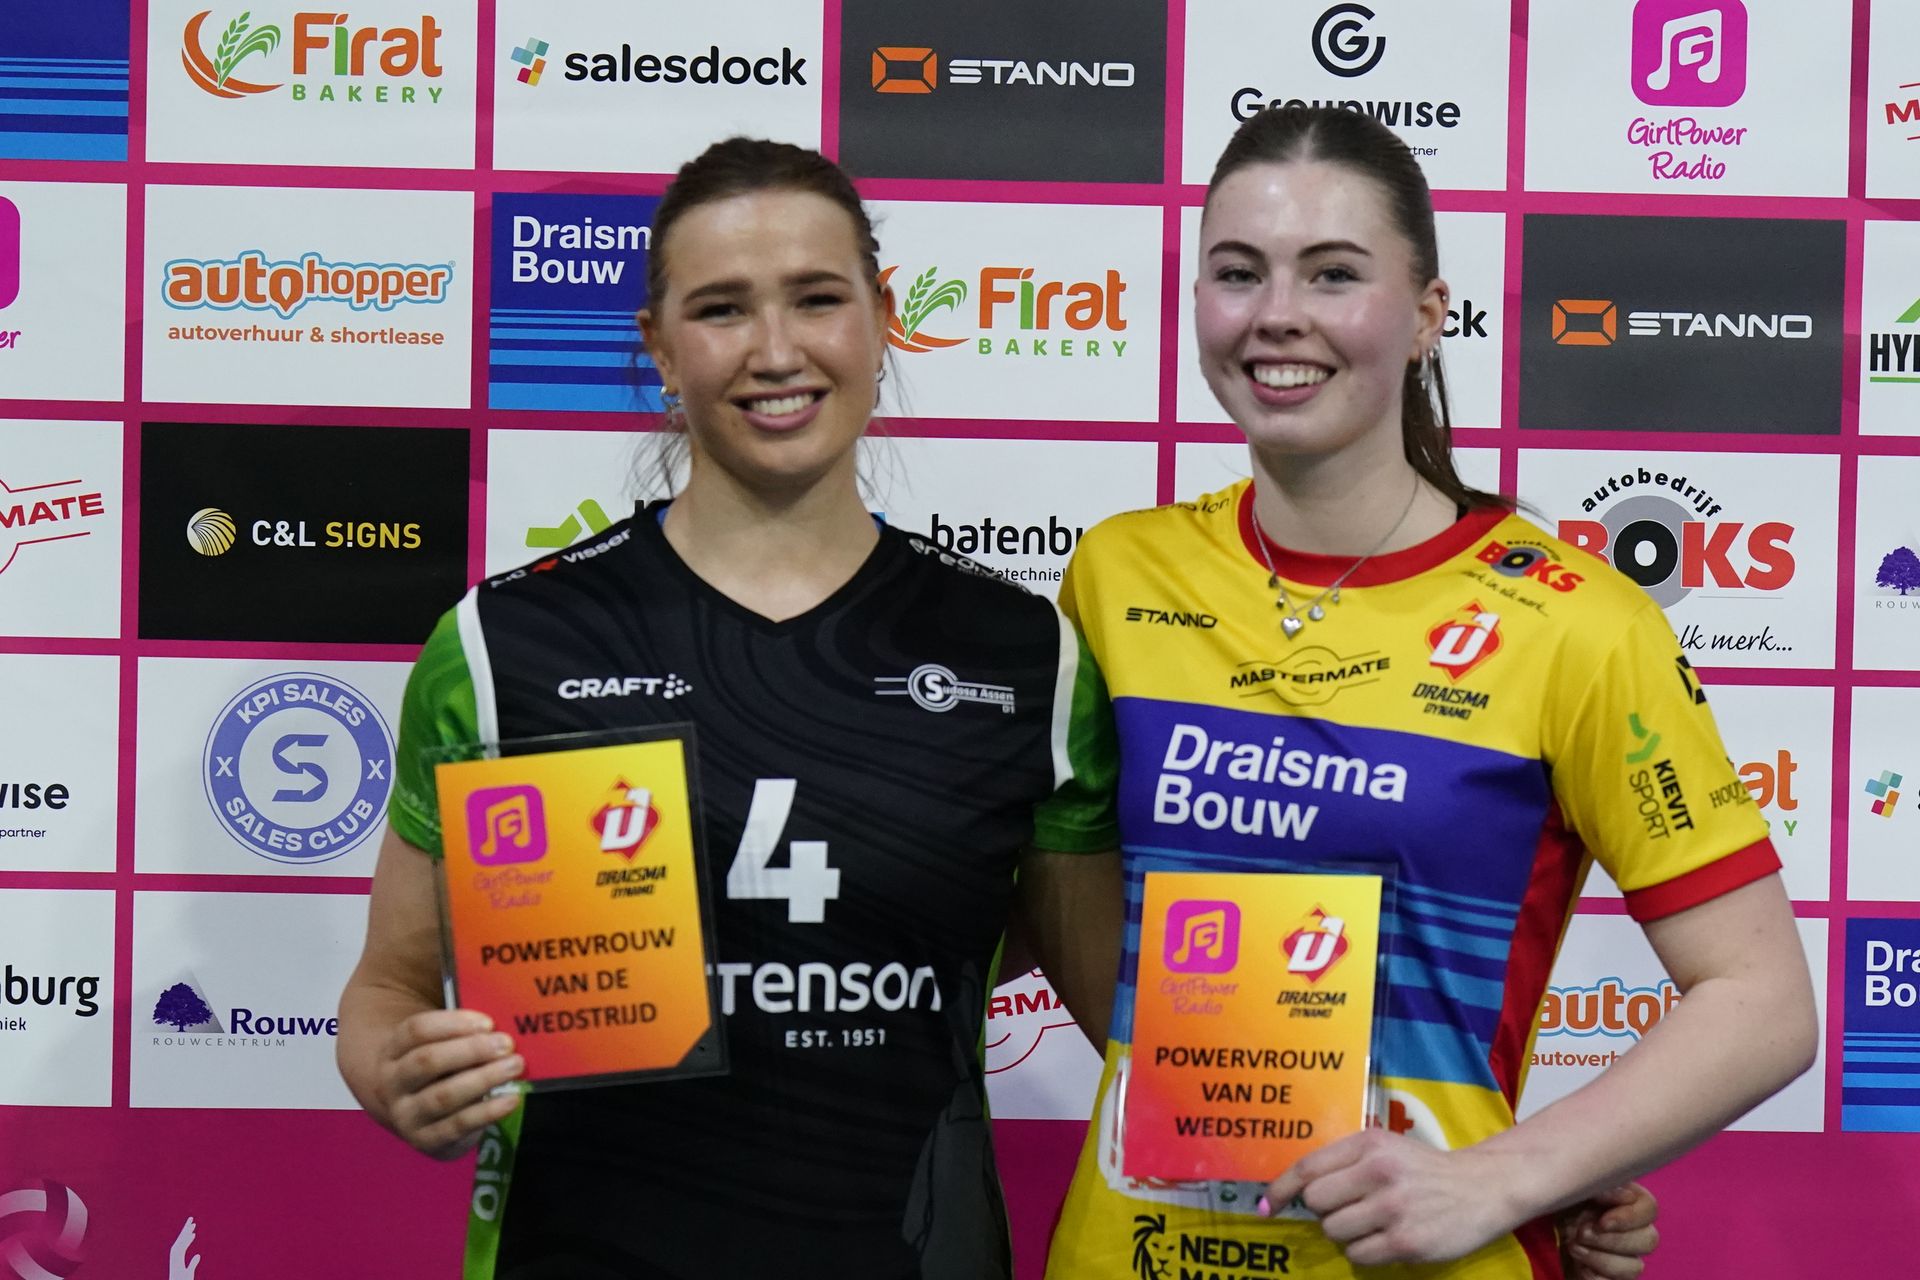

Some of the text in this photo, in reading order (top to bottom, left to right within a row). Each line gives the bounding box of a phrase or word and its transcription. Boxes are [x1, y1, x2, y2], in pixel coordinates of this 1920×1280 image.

[293, 12, 443, 78] Firat
[565, 43, 808, 86] salesdock
[949, 59, 1135, 87] STANNO
[292, 84, 443, 104] BAKERY
[1627, 117, 1747, 147] GirlPower
[1648, 151, 1726, 180] Radio
[513, 215, 652, 250] Draism
[512, 250, 625, 285] Bouw
[169, 257, 446, 313] autohopper
[979, 267, 1127, 332] Firat
[168, 324, 445, 346] autoverhuur & shortlease
[1628, 311, 1813, 339] STANNO
[978, 338, 1128, 358] BAKERY
[1581, 467, 1723, 518] autobedrijf
[252, 520, 317, 547] C&L
[1475, 540, 1586, 592] BOKS
[1126, 607, 1218, 629] STANNO
[1675, 624, 1793, 651] lk merk...
[558, 677, 664, 699] CRAFT
[1230, 657, 1391, 689] MASTERMATE
[236, 683, 366, 727] KPI SALES
[1412, 682, 1491, 709] DRAISMA
[1162, 723, 1408, 803] Draisma
[1653, 758, 1695, 832] KIEVIT
[1730, 749, 1798, 811] at
[1153, 772, 1320, 842] Bouw
[1629, 769, 1671, 841] SPORT
[225, 796, 374, 852] SALES CLUB
[726, 778, 841, 923] 4
[481, 926, 676, 967] POWERVROUW
[0, 965, 100, 1017] burg
[533, 968, 629, 997] VAN DE
[1276, 990, 1347, 1006] DRAISMA
[1865, 974, 1920, 1008] Bo
[0, 1017, 27, 1031] iek
[231, 1008, 339, 1036] Rouwe
[514, 1002, 658, 1036] WEDSTRIJD
[153, 1037, 286, 1047] ROUWCENTRUM
[785, 1029, 886, 1048] EST. 1951
[1155, 1046, 1345, 1071] POWERVROUW
[1202, 1082, 1293, 1104] VAN DE
[1175, 1115, 1314, 1140] WEDSTRIJD
[1179, 1233, 1291, 1274] NEDER
